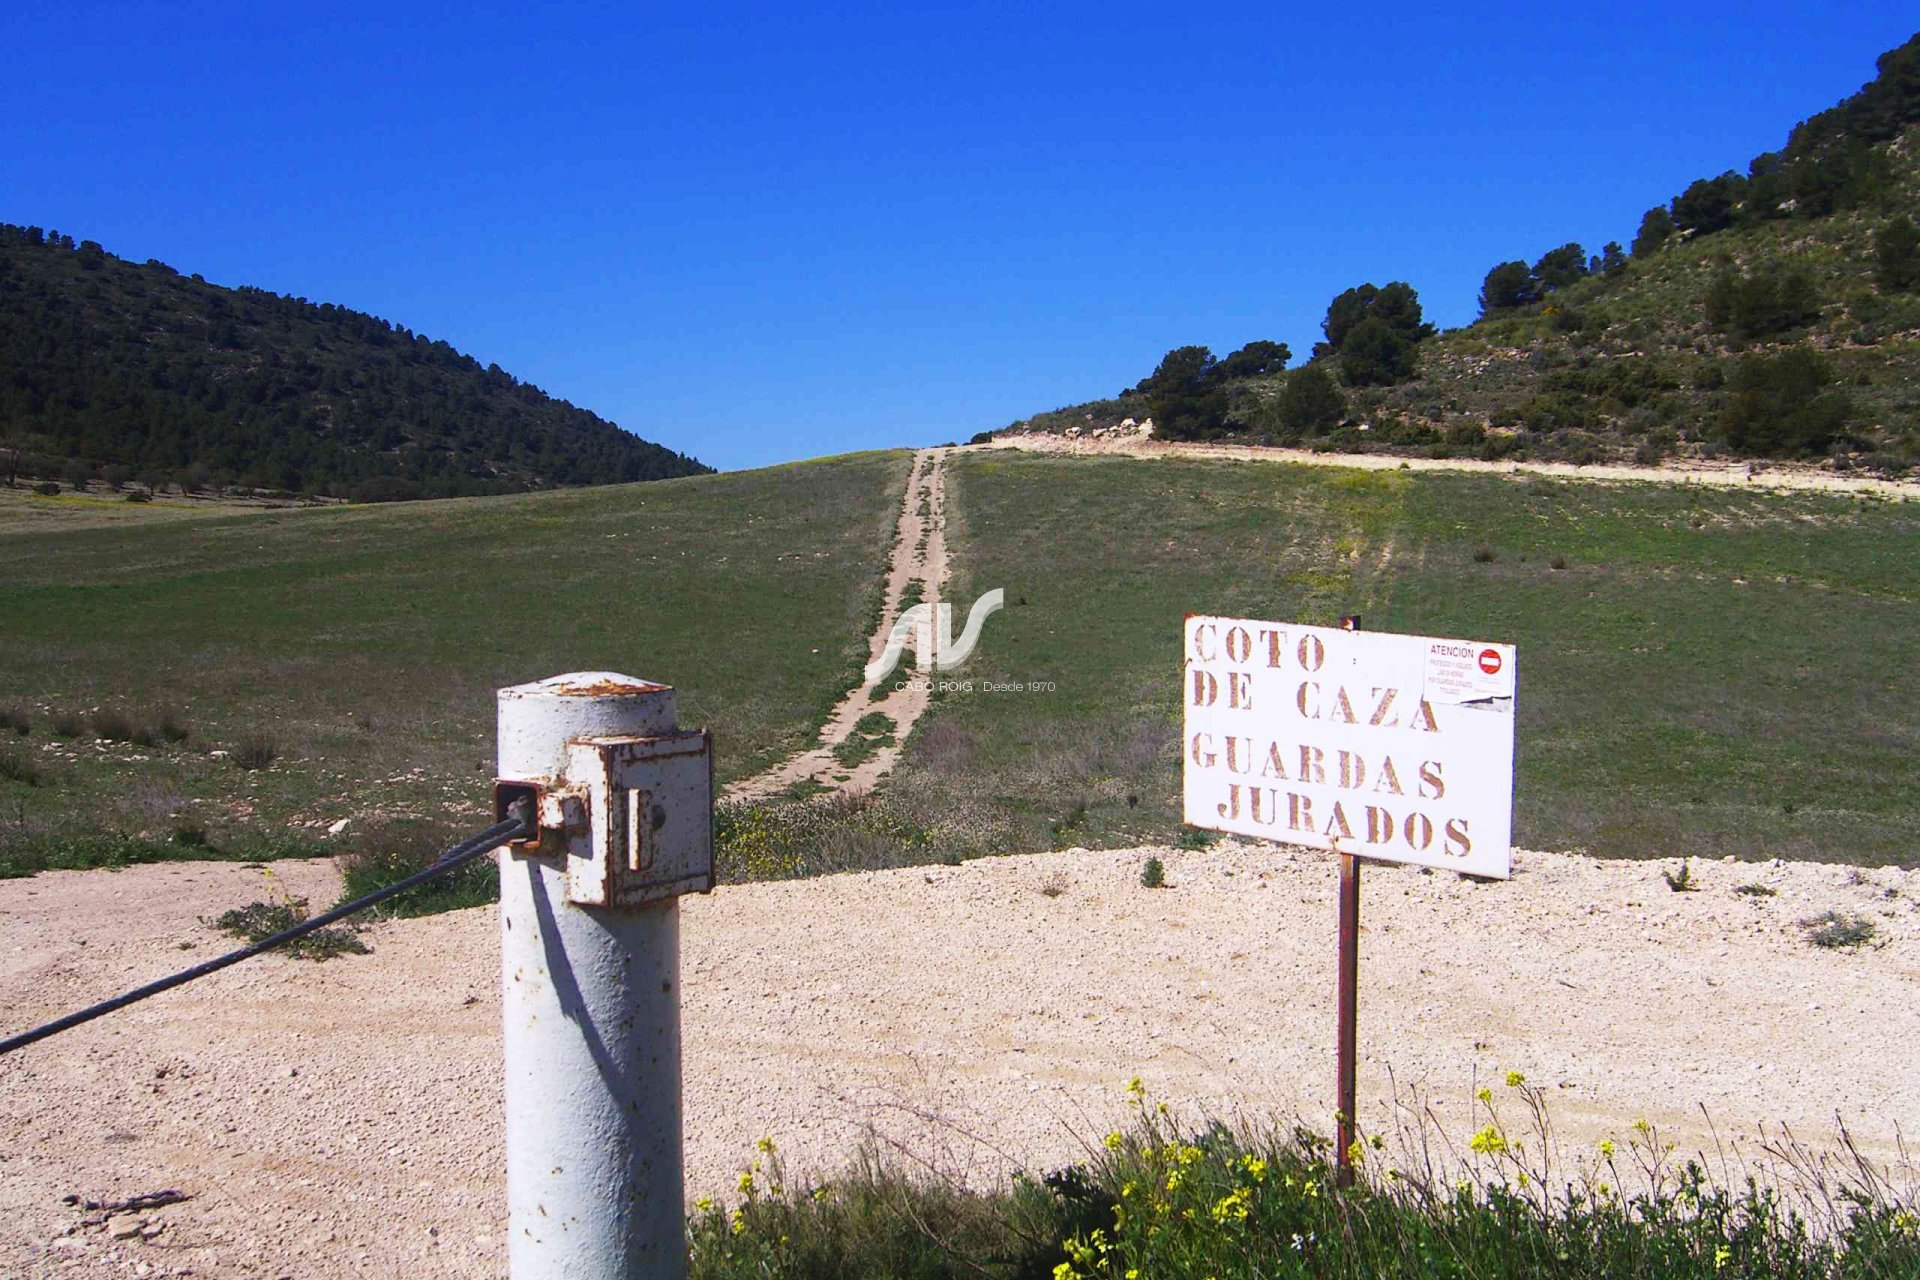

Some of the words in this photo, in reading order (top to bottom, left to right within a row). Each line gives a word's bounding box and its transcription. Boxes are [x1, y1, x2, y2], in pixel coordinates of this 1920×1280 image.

[1194, 624, 1325, 672] COTO
[1430, 644, 1474, 659] ATENCION
[1192, 669, 1252, 710] DE
[1296, 681, 1442, 732] CAZA
[1191, 732, 1445, 800] GUARDAS
[1217, 783, 1472, 857] JURADOS
